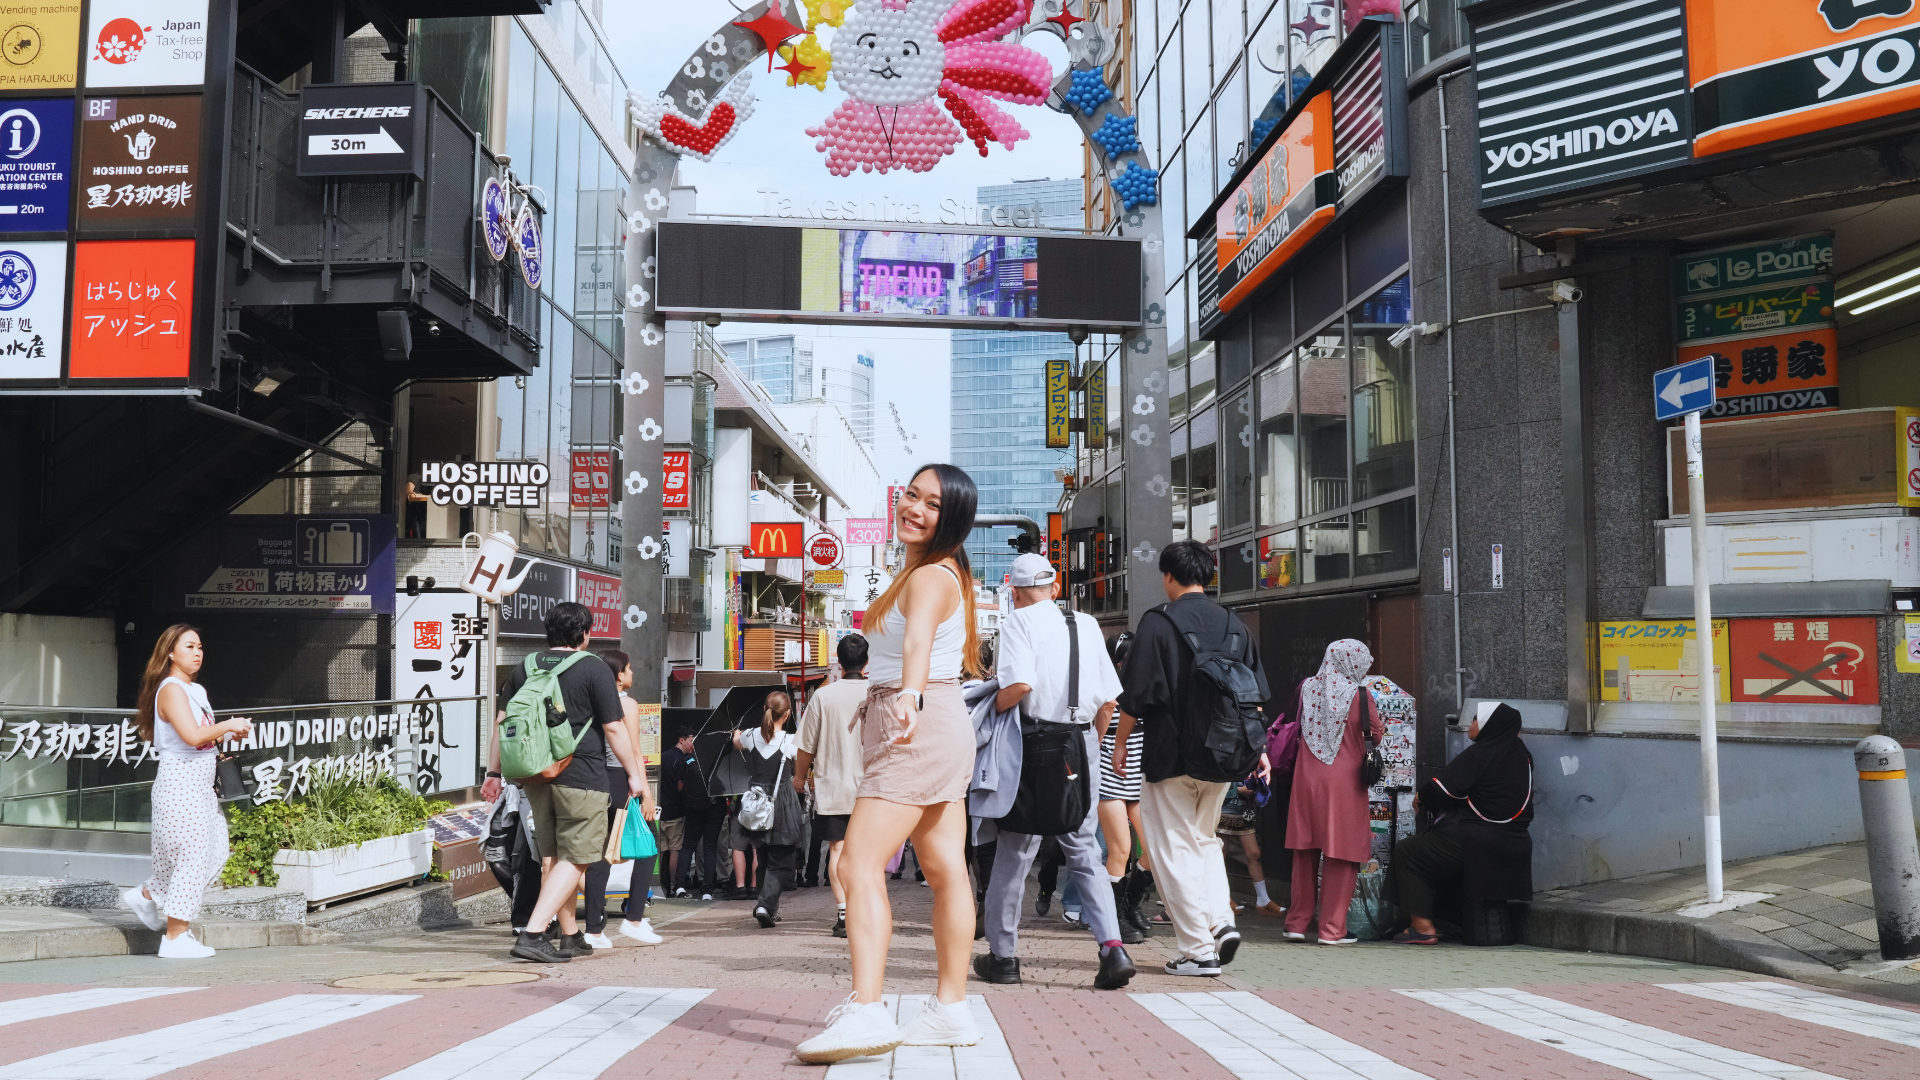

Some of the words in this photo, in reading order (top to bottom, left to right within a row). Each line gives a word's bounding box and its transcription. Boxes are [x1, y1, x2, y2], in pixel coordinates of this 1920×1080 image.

[0, 6, 38, 16] Vending
[40, 4, 79, 13] machine
[162, 20, 201, 32] Japan
[156, 34, 204, 46] Tax-free
[172, 48, 203, 61] Shop
[1813, 36, 1920, 98] YO
[19, 74, 74, 83] HARAJUKU
[90, 100, 112, 117] BF
[303, 105, 412, 120] SKECHERS
[110, 114, 144, 133] HAND
[148, 114, 177, 130] DRIP
[330, 138, 366, 151] 30m
[1485, 107, 1679, 175] YOSHINOYA
[18, 162, 56, 171] TOURIST
[92, 166, 143, 176] HOSHINO
[146, 164, 189, 174] COFFEE
[28, 172, 63, 181] CENTER
[86, 180, 194, 210] 星乃珈琲
[20, 204, 44, 214] 20m
[756, 186, 924, 222] Takeshita
[940, 197, 1046, 230] Street
[1236, 214, 1290, 280] YOSHINOYA
[1756, 243, 1833, 270] Ponte
[858, 262, 942, 298] TREND
[86, 280, 178, 301] はらじゅく
[84, 314, 178, 338] アッシュ
[0, 334, 46, 359] 水産
[1050, 362, 1068, 436] コインロッカー
[1701, 390, 1828, 417] OSHINOYA
[422, 462, 549, 485] HOSHINO
[662, 471, 686, 489] S
[432, 484, 538, 506] COFFEE
[258, 538, 293, 548] Baggage
[850, 530, 882, 543] ¥300
[262, 548, 293, 557] Storage
[812, 546, 836, 558] 消火栓
[263, 557, 293, 566] Service
[274, 572, 368, 592] 荷物預かり
[526, 570, 548, 582] AMEN
[216, 582, 234, 592] 左手
[236, 578, 265, 592] 20m
[188, 596, 326, 607] 原宿ツーリストインフォメーションセンター
[514, 592, 564, 622] IPPUD
[458, 618, 480, 635] BF
[1602, 624, 1696, 638] コインロッカー
[1773, 621, 1829, 642] 禁煙
[296, 714, 346, 746] DRIP
[350, 712, 420, 741] COFFEE
[0, 718, 160, 770] 乃珈琲
